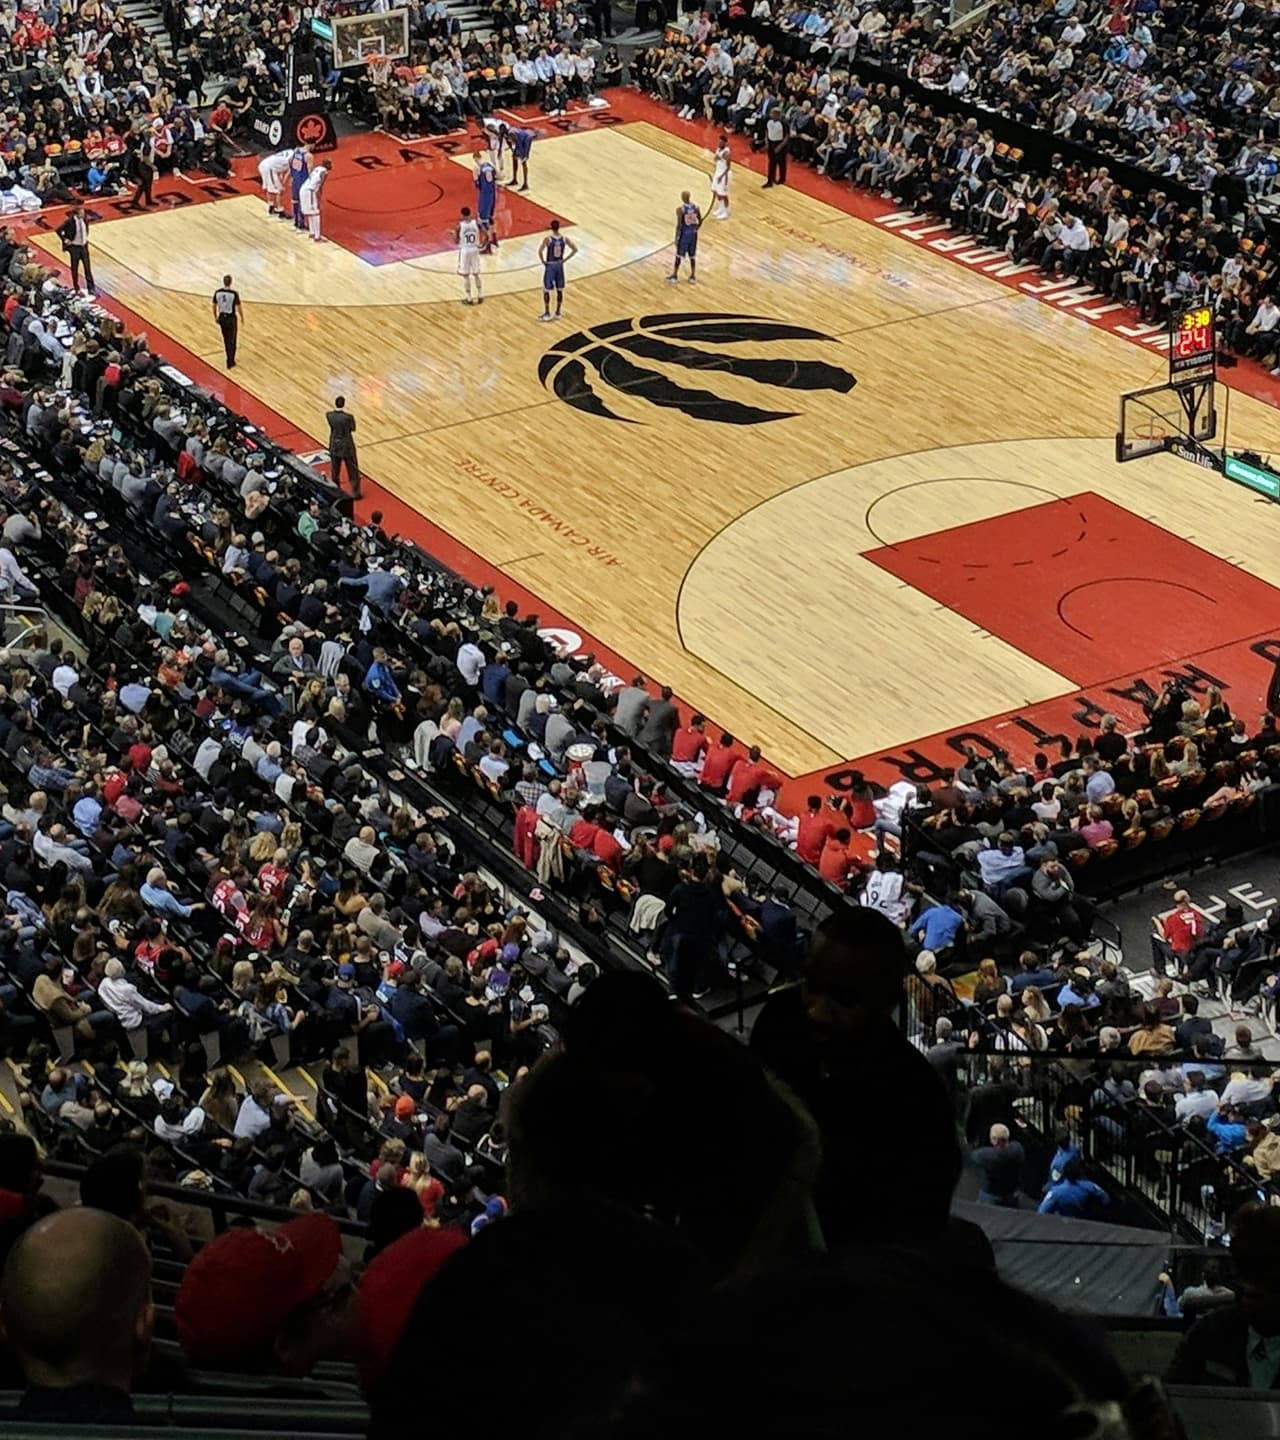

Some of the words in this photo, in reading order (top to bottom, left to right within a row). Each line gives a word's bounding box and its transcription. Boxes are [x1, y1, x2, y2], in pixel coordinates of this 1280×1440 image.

[297, 73, 314, 85] ON
[465, 233, 476, 244] 10
[1020, 275, 1124, 320] THE
[1183, 310, 1211, 330] 3:38
[1179, 329, 1207, 356] 24
[456, 459, 519, 500] CENTRE
[519, 500, 590, 545] CANADA
[588, 546, 621, 567] AIR
[1185, 919, 1197, 936] 7
